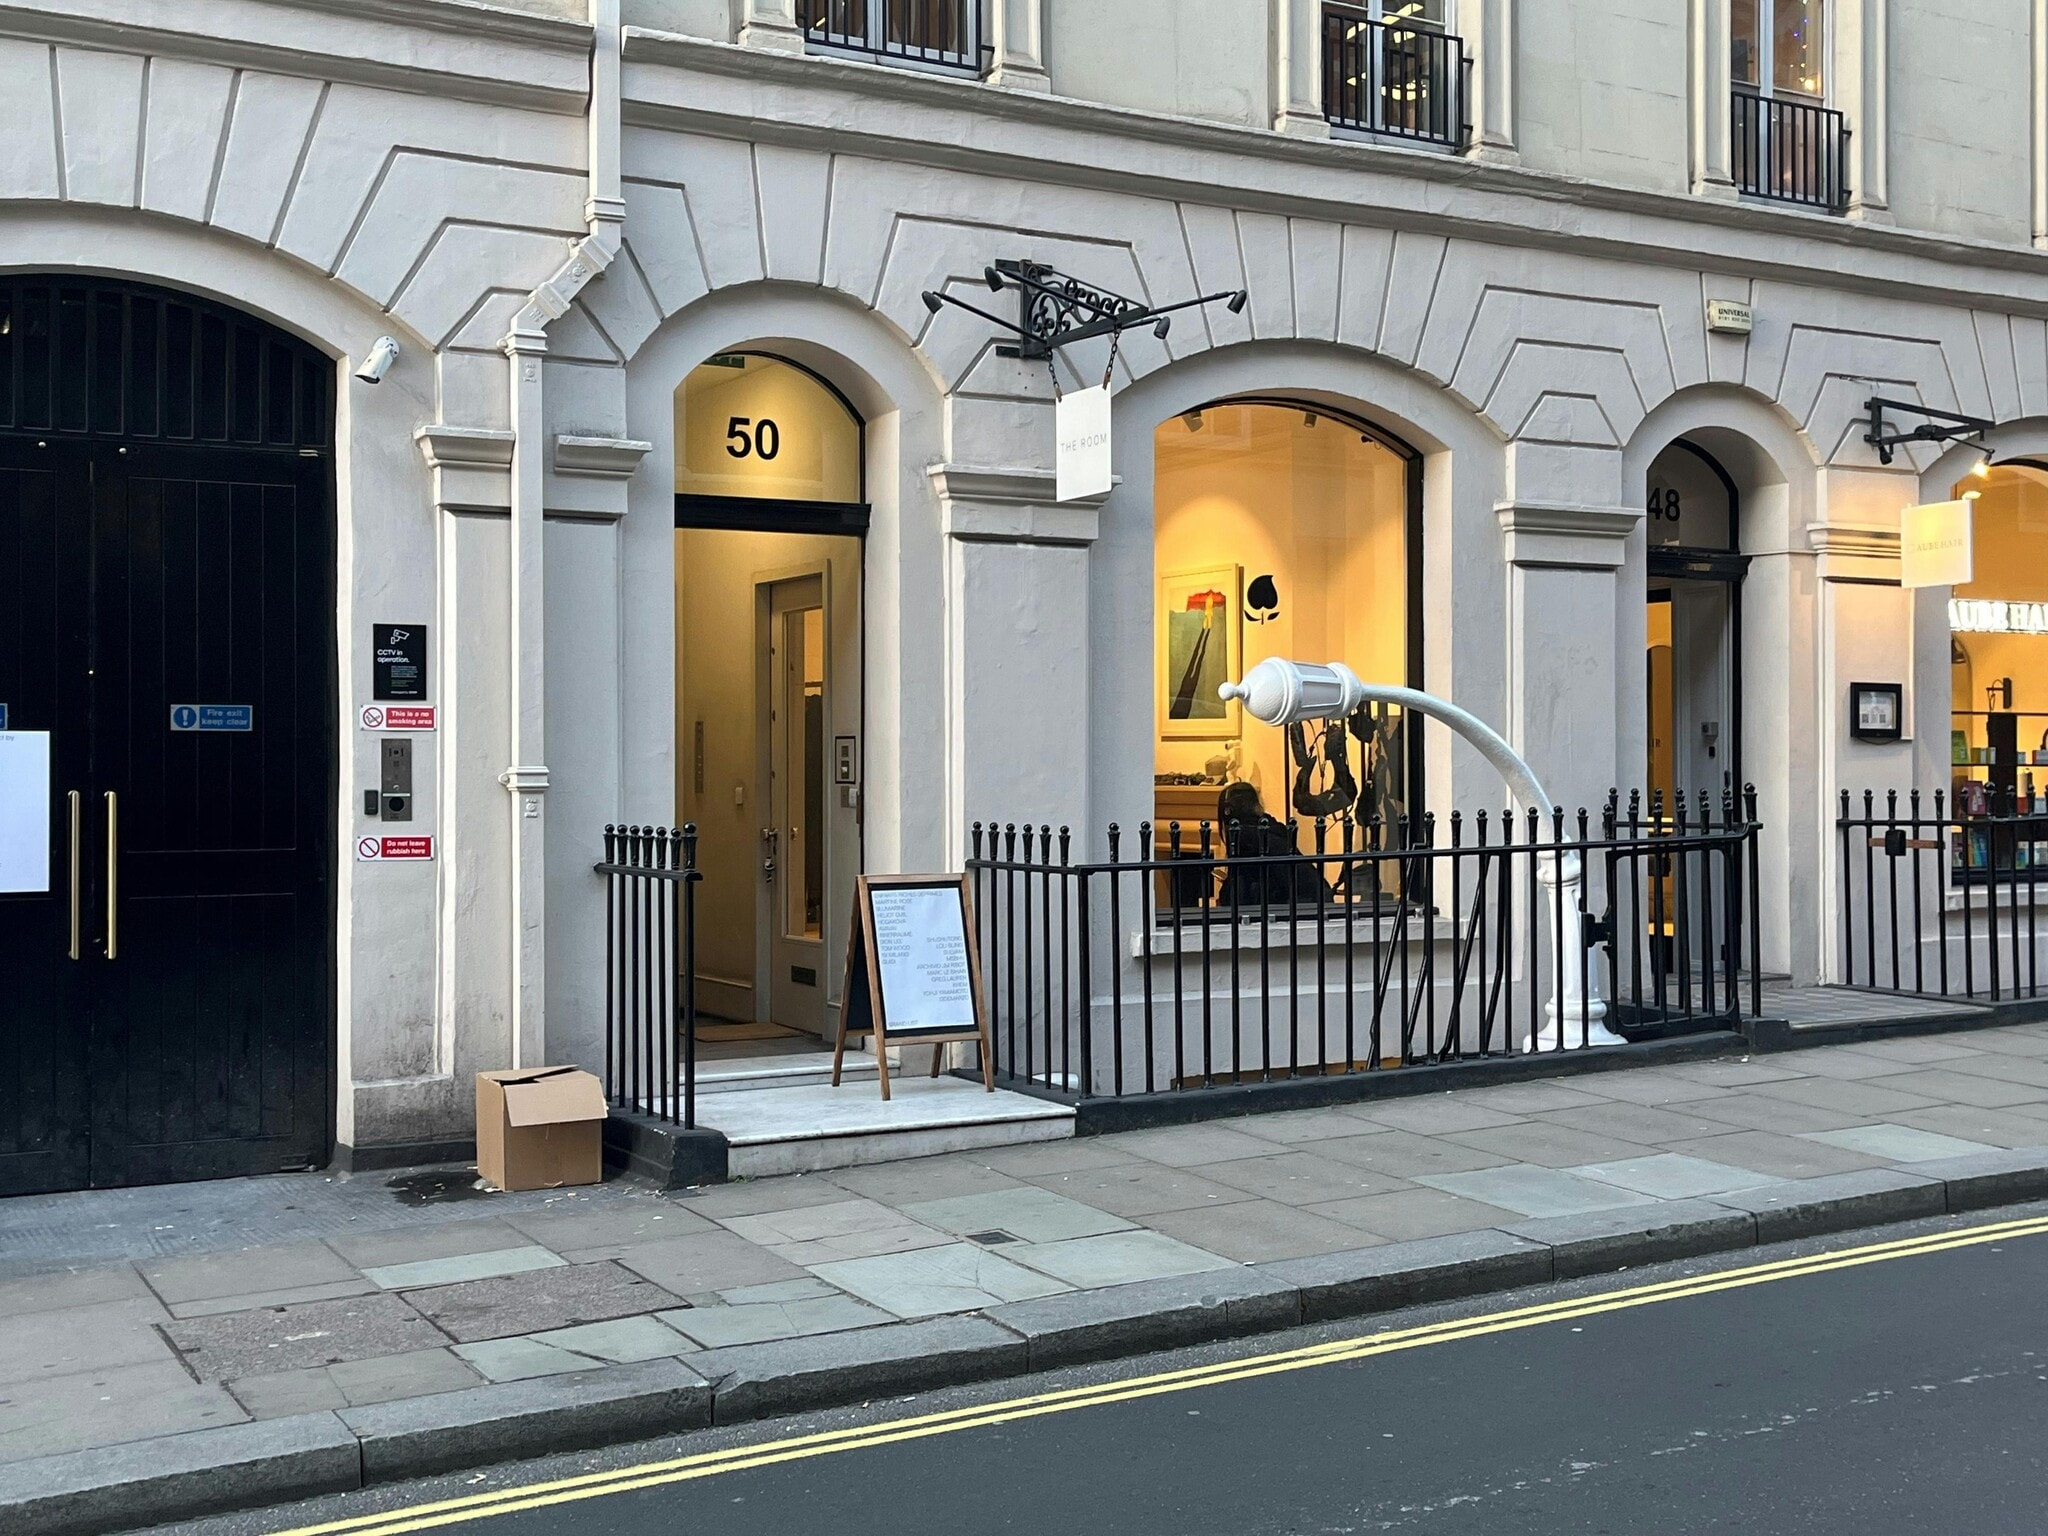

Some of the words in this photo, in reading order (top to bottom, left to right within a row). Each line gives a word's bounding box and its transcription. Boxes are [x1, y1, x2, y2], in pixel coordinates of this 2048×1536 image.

[1718, 308, 1750, 318] UNIVERSAL
[726, 416, 779, 460] 50
[1060, 440, 1077, 454] THE
[1080, 433, 1107, 449] ROOM
[1646, 487, 1680, 521] 48
[377, 656, 410, 664] operation.
[226, 709, 243, 717] exit
[202, 718, 223, 726] keep
[388, 718, 416, 726] smoking
